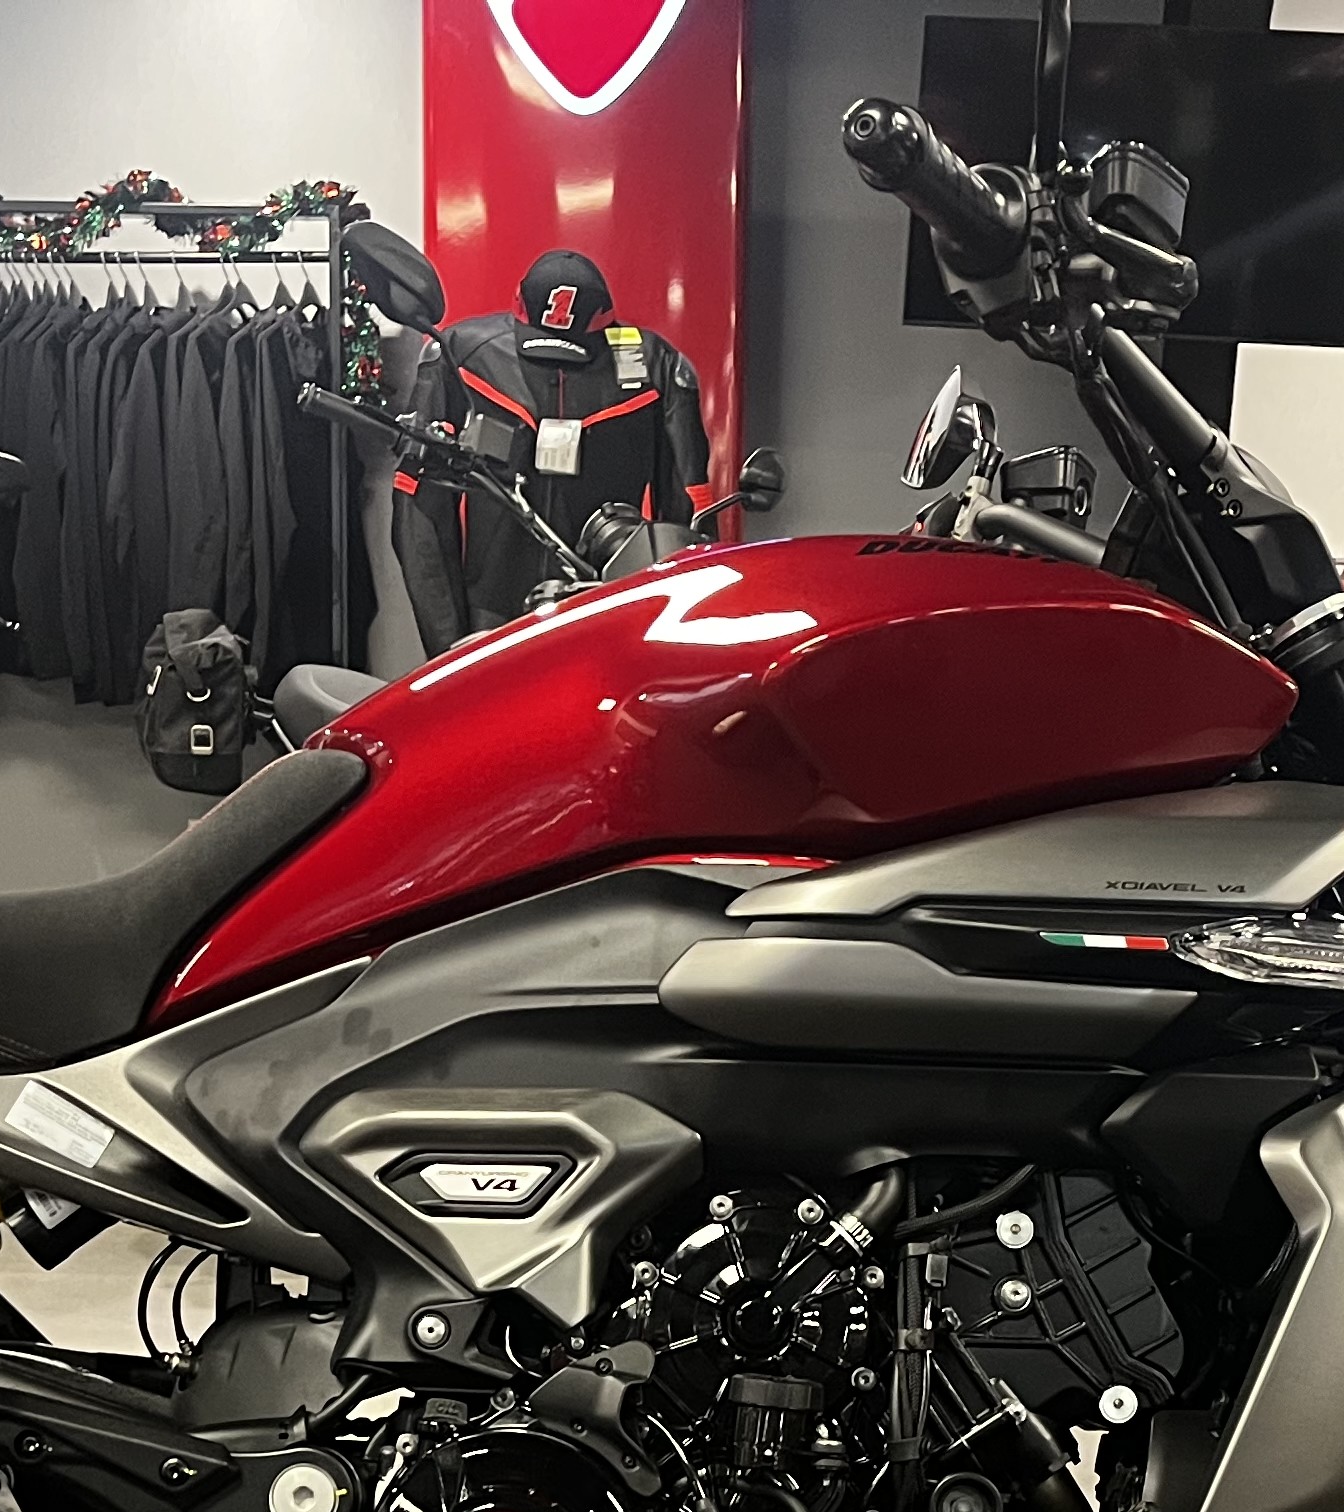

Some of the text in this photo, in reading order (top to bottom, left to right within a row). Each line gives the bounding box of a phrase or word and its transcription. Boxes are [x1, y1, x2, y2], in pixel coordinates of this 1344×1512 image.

[541, 285, 577, 330] 1
[1105, 880, 1246, 893] XDIAVEL V4
[471, 1178, 520, 1191] V4
